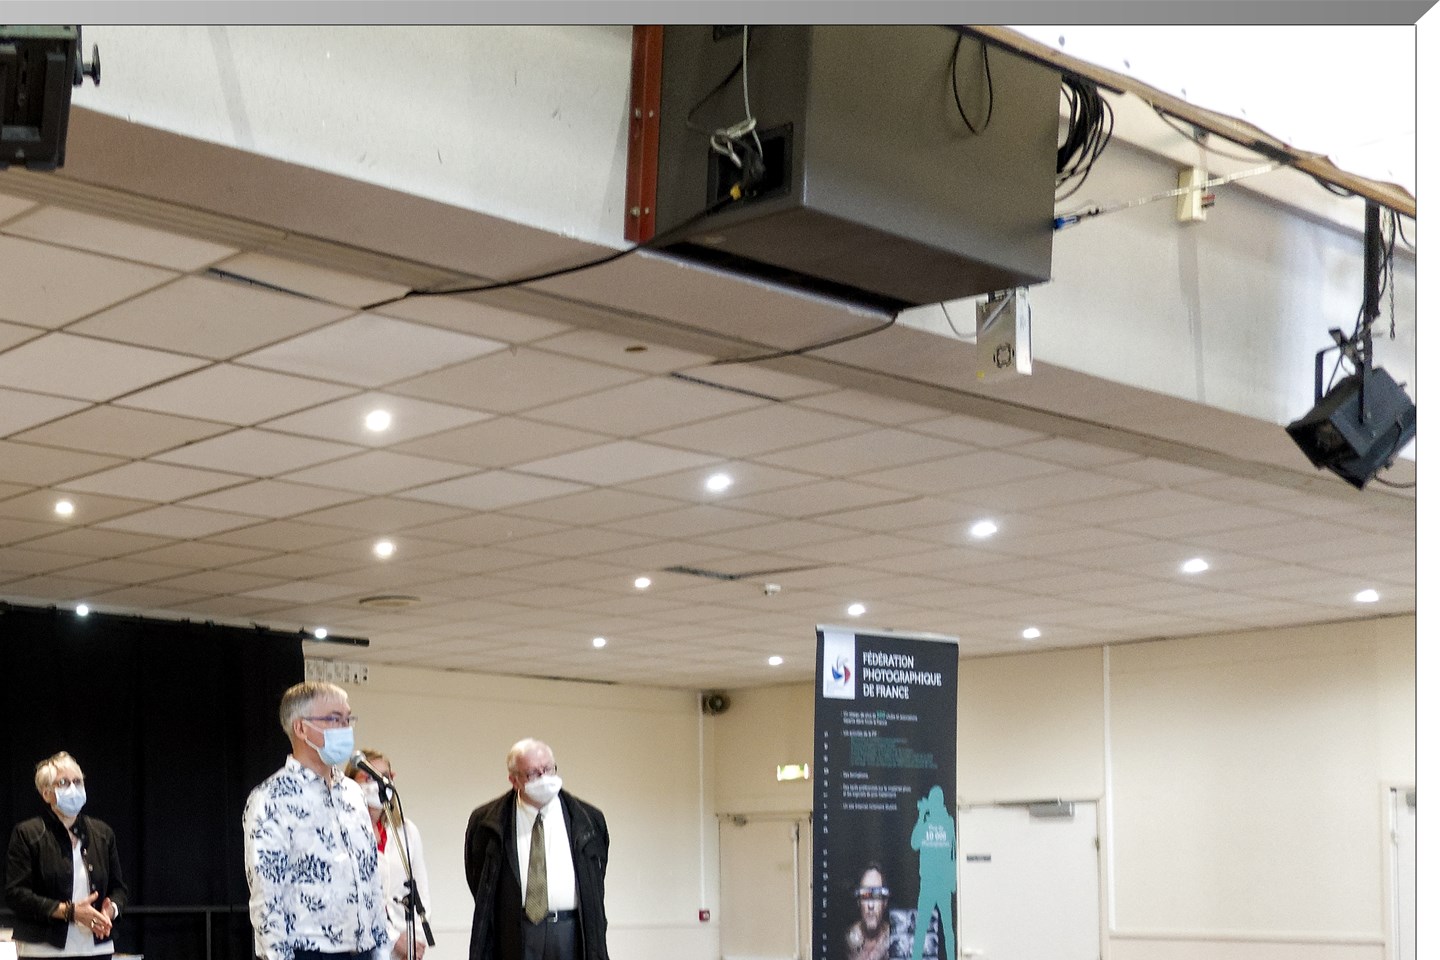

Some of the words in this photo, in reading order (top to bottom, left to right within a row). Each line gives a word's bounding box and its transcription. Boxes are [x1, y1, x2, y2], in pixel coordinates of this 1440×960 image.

[863, 651, 914, 669] FÉDÉRATION
[863, 667, 942, 687] PHOTOGRAPHIQUE
[863, 683, 875, 698] DE
[876, 684, 909, 700] FRANCE
